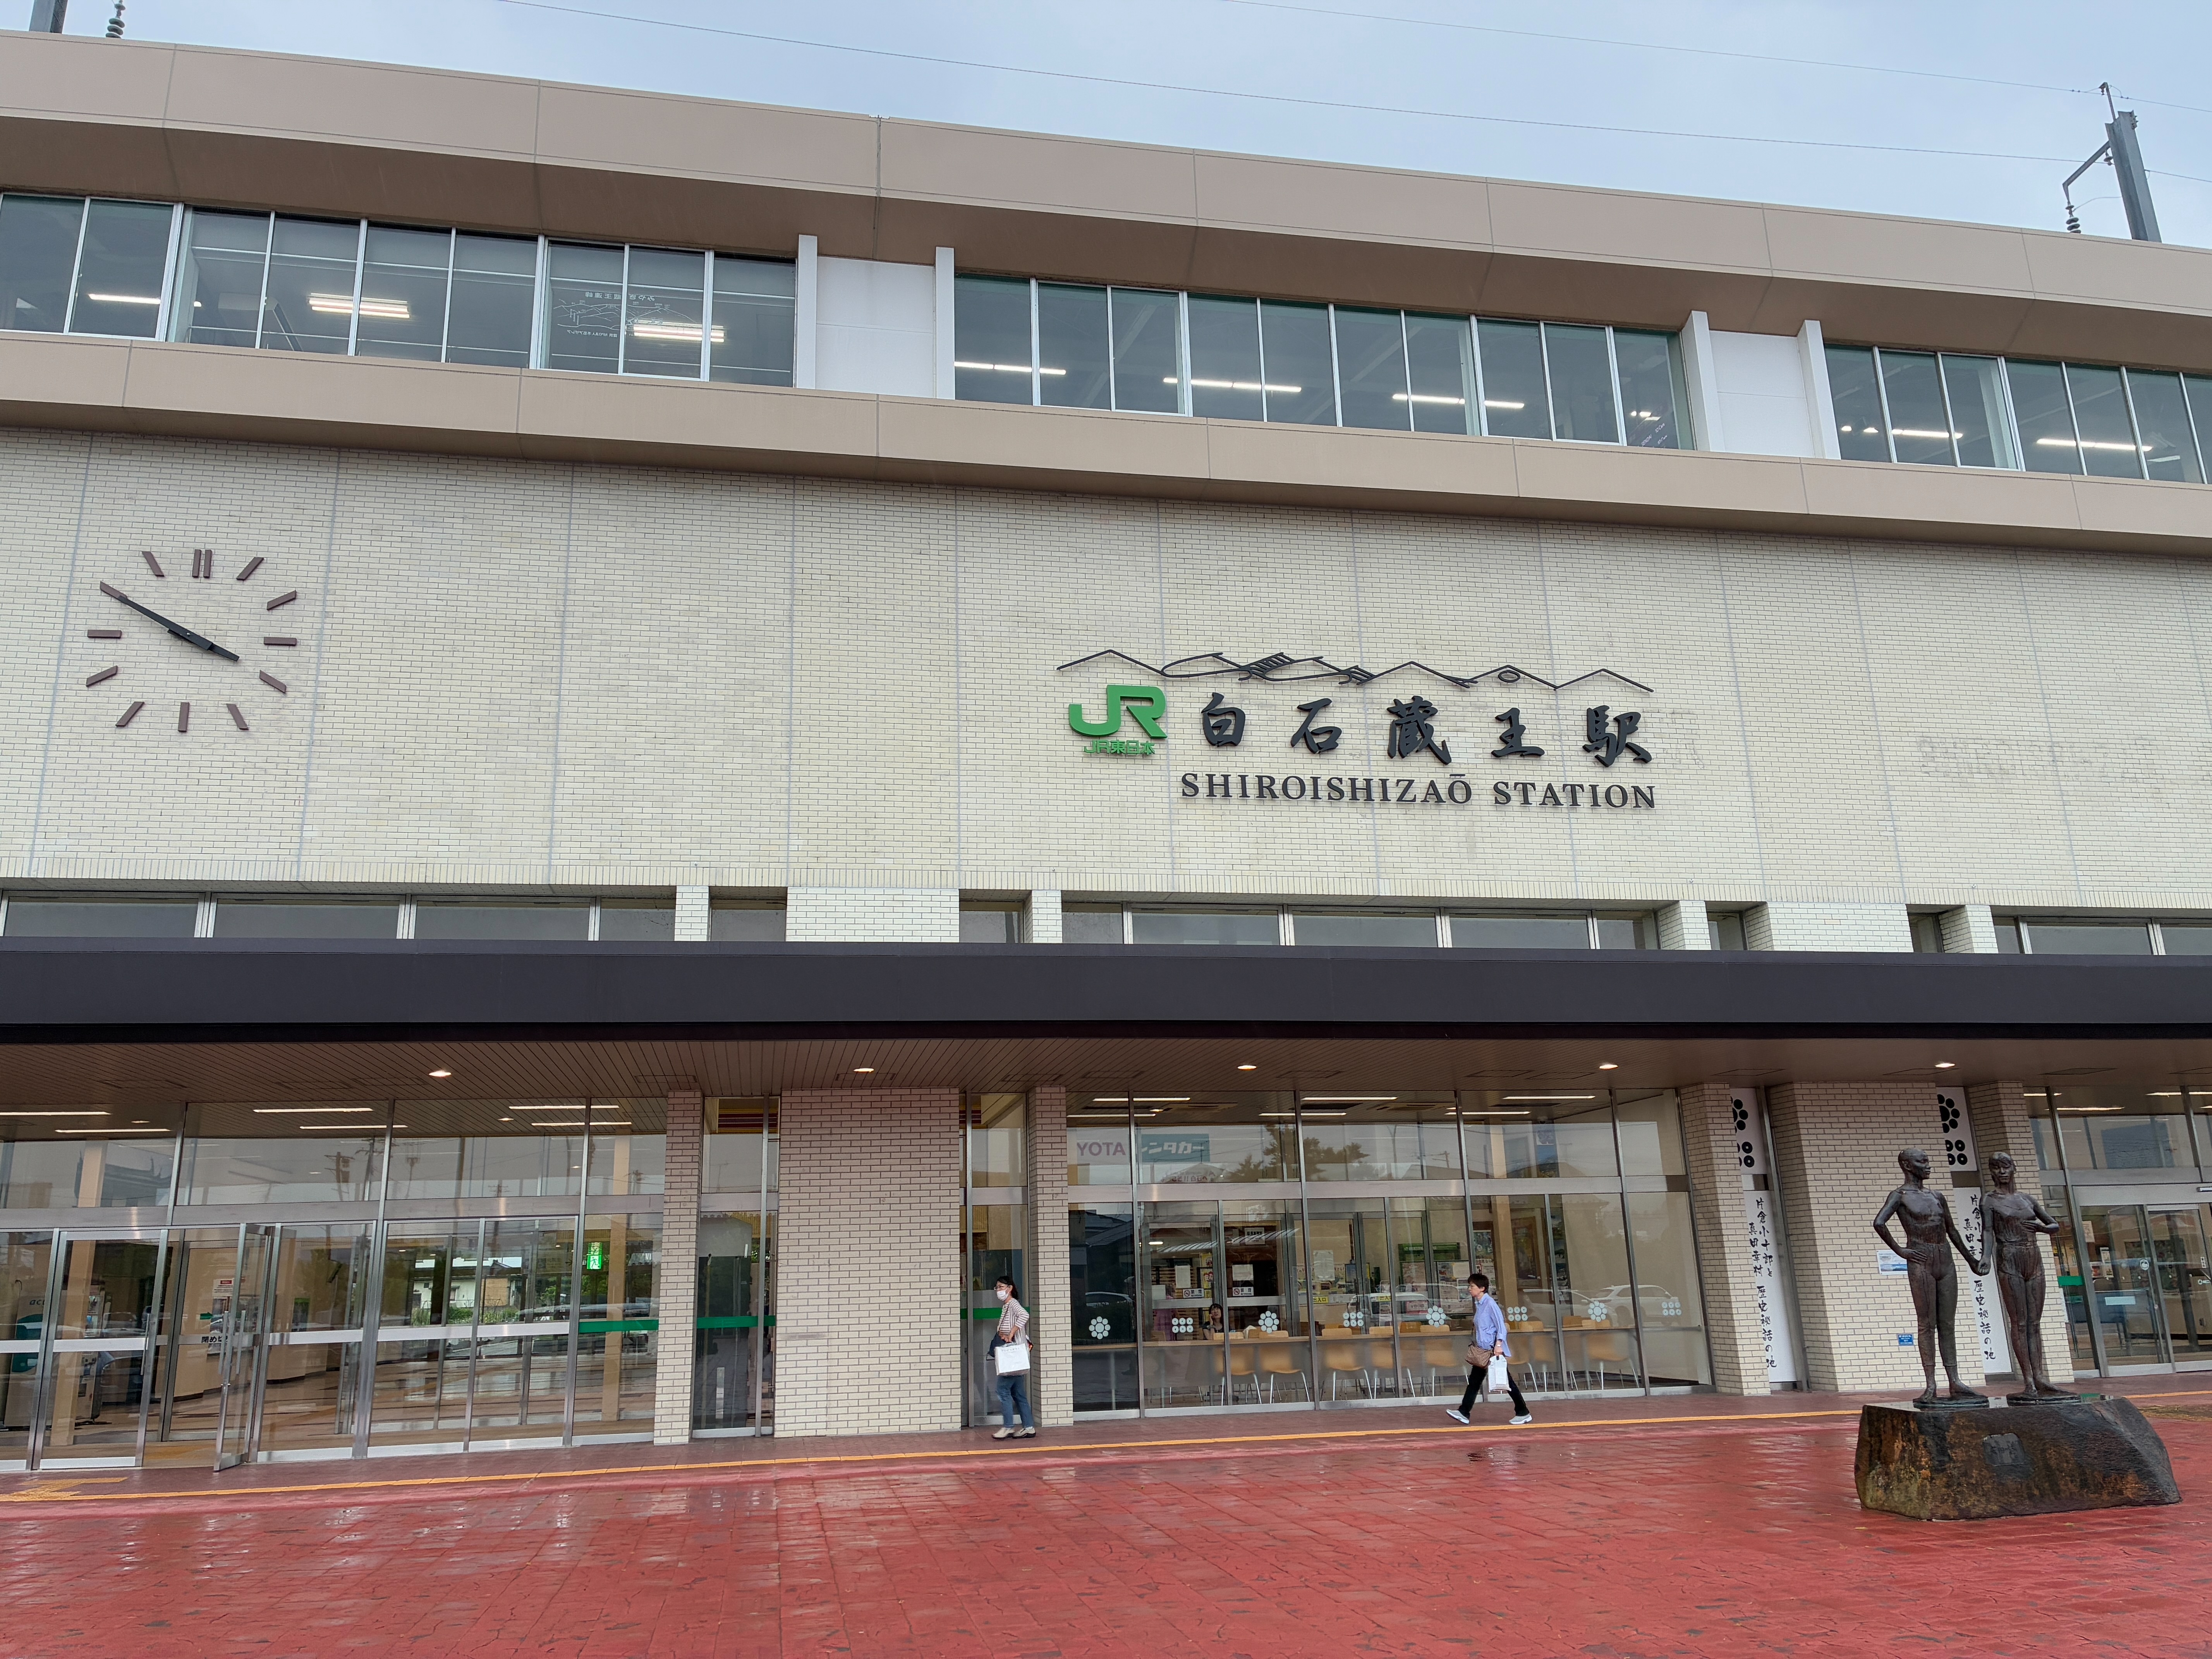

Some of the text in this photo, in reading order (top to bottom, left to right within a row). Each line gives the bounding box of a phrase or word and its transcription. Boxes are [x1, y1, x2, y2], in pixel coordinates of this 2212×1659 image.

[1068, 684, 1168, 739] JR
[1201, 692, 1652, 767] 白石蔵王駅
[1084, 739, 1155, 755] JR東日本
[1182, 773, 1655, 808] SHIROISHIZAŌ STATION
[1748, 1222, 1763, 1276] 真田幸村
[1756, 1197, 1773, 1277] 片倉小十郎と
[1757, 1285, 1777, 1368] 歴史秘話の地
[1974, 1280, 1996, 1360] 歴史秘話の地
